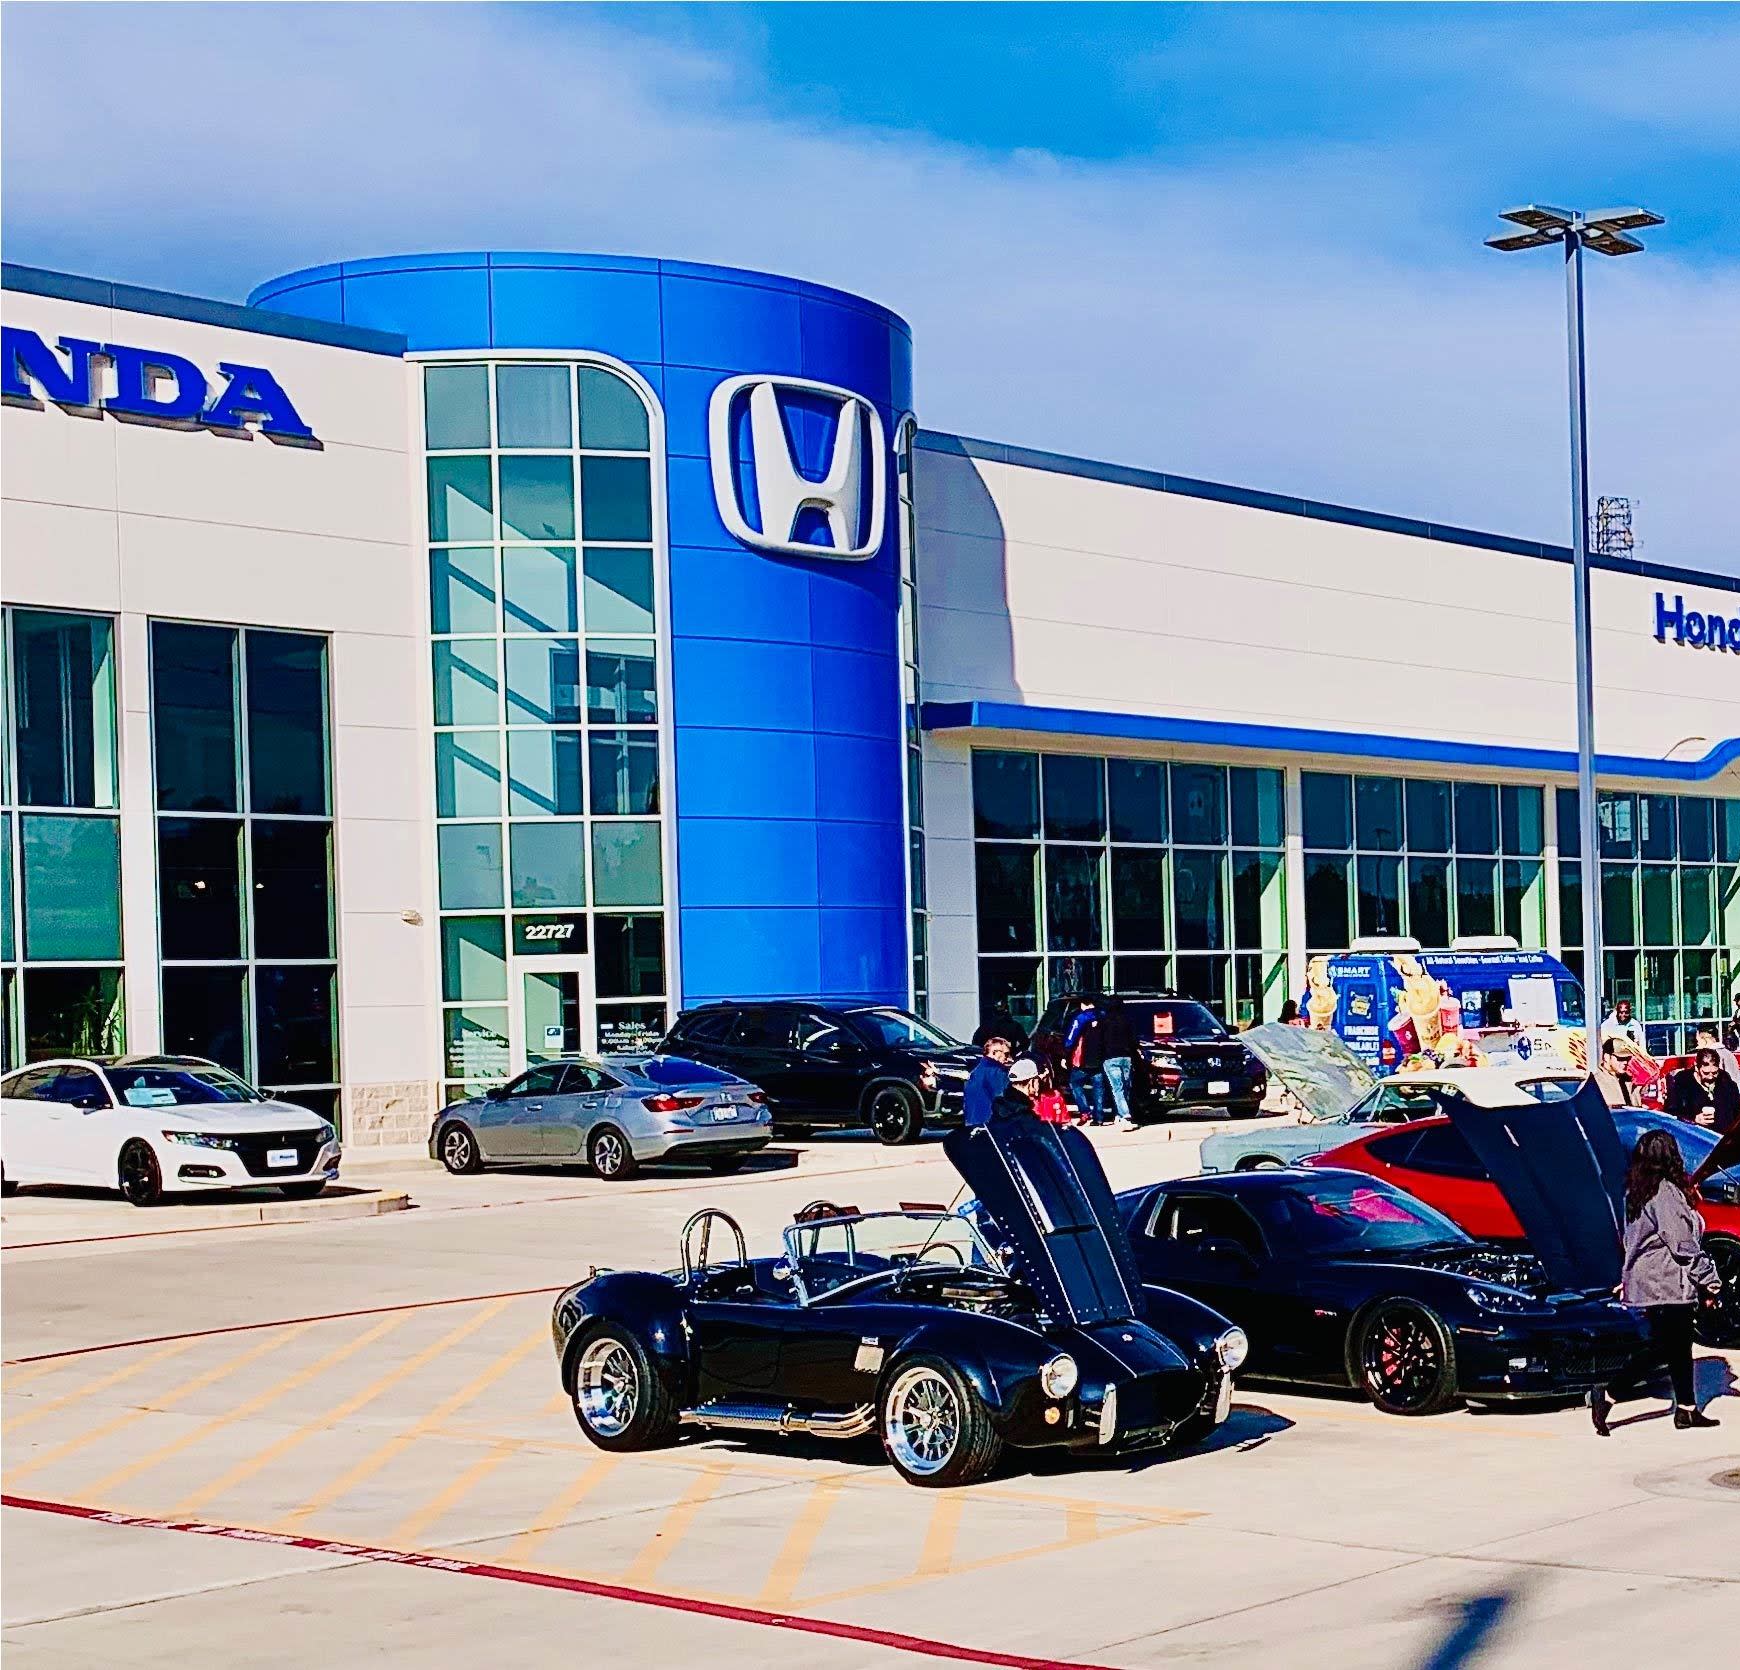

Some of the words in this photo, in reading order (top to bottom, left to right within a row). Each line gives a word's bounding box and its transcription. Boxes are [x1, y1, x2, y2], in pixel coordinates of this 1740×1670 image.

[525, 924, 575, 940] 22727
[1337, 966, 1371, 974] SMART
[618, 1021, 647, 1030] Sales
